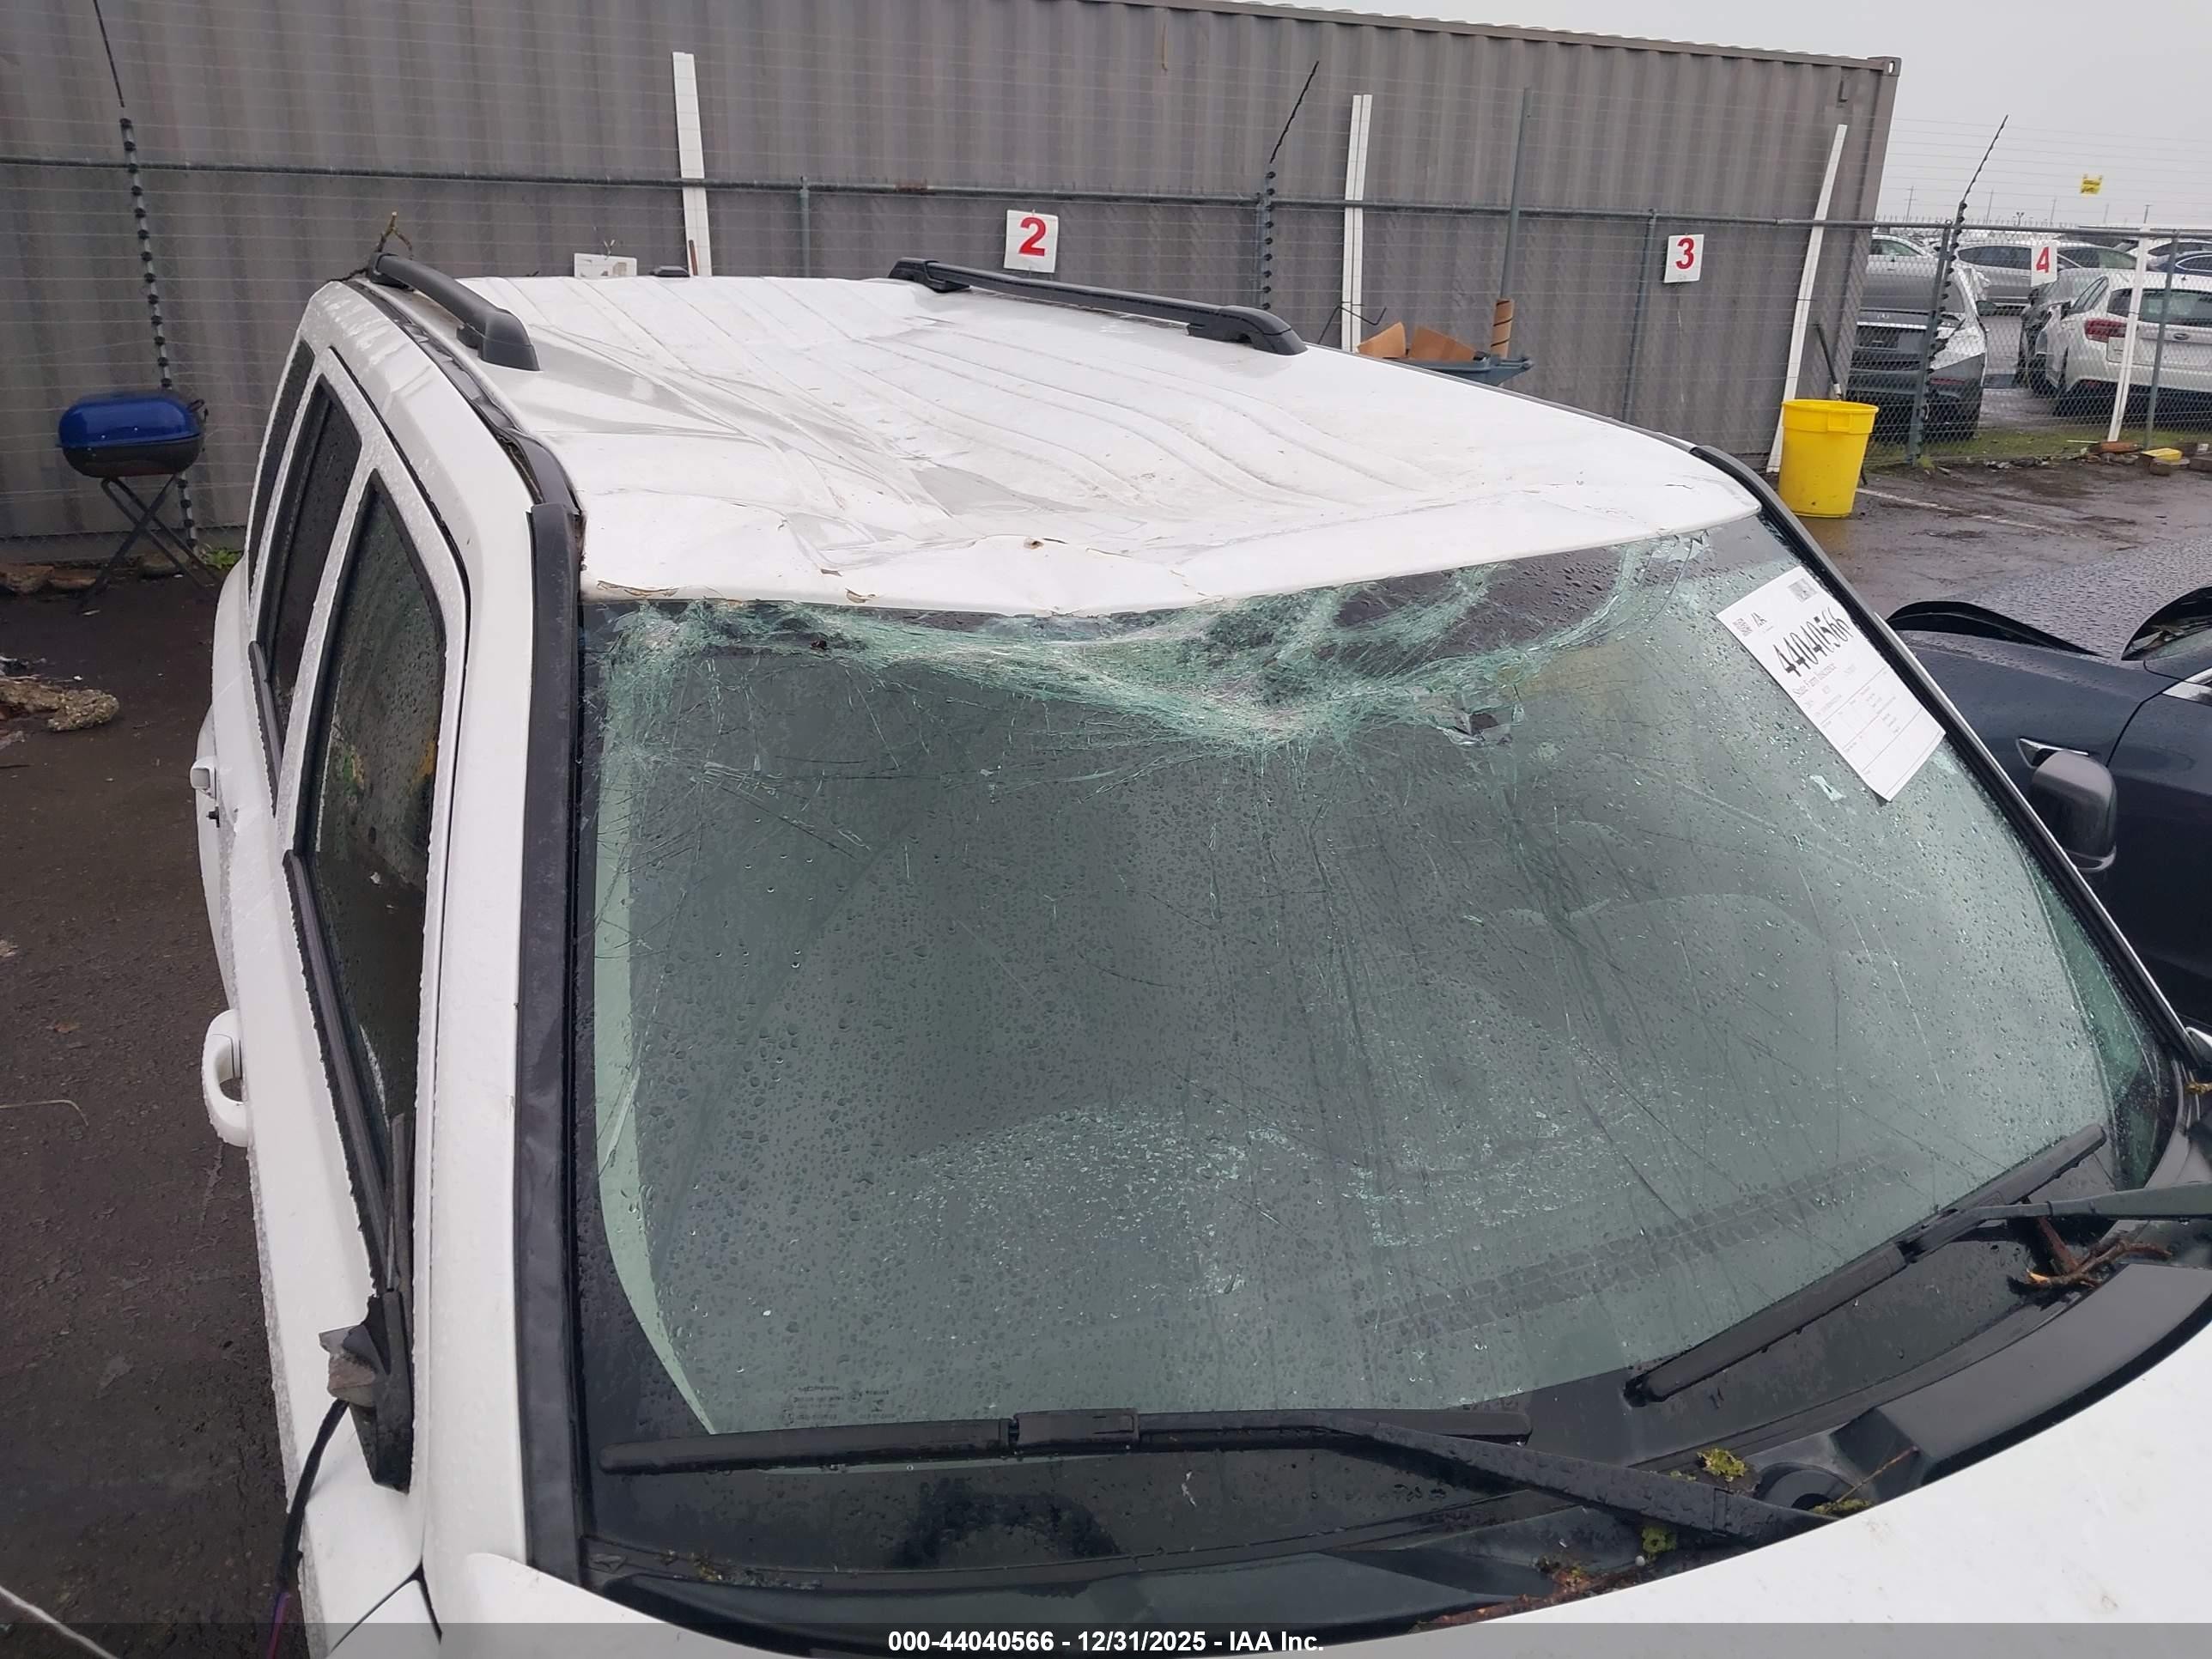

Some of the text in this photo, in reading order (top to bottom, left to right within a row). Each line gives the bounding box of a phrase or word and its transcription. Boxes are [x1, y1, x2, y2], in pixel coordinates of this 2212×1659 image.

[1018, 216, 1046, 257] 2
[1675, 237, 1694, 270] 3
[2035, 246, 2050, 274] 4
[1773, 606, 1854, 678] 44040566
